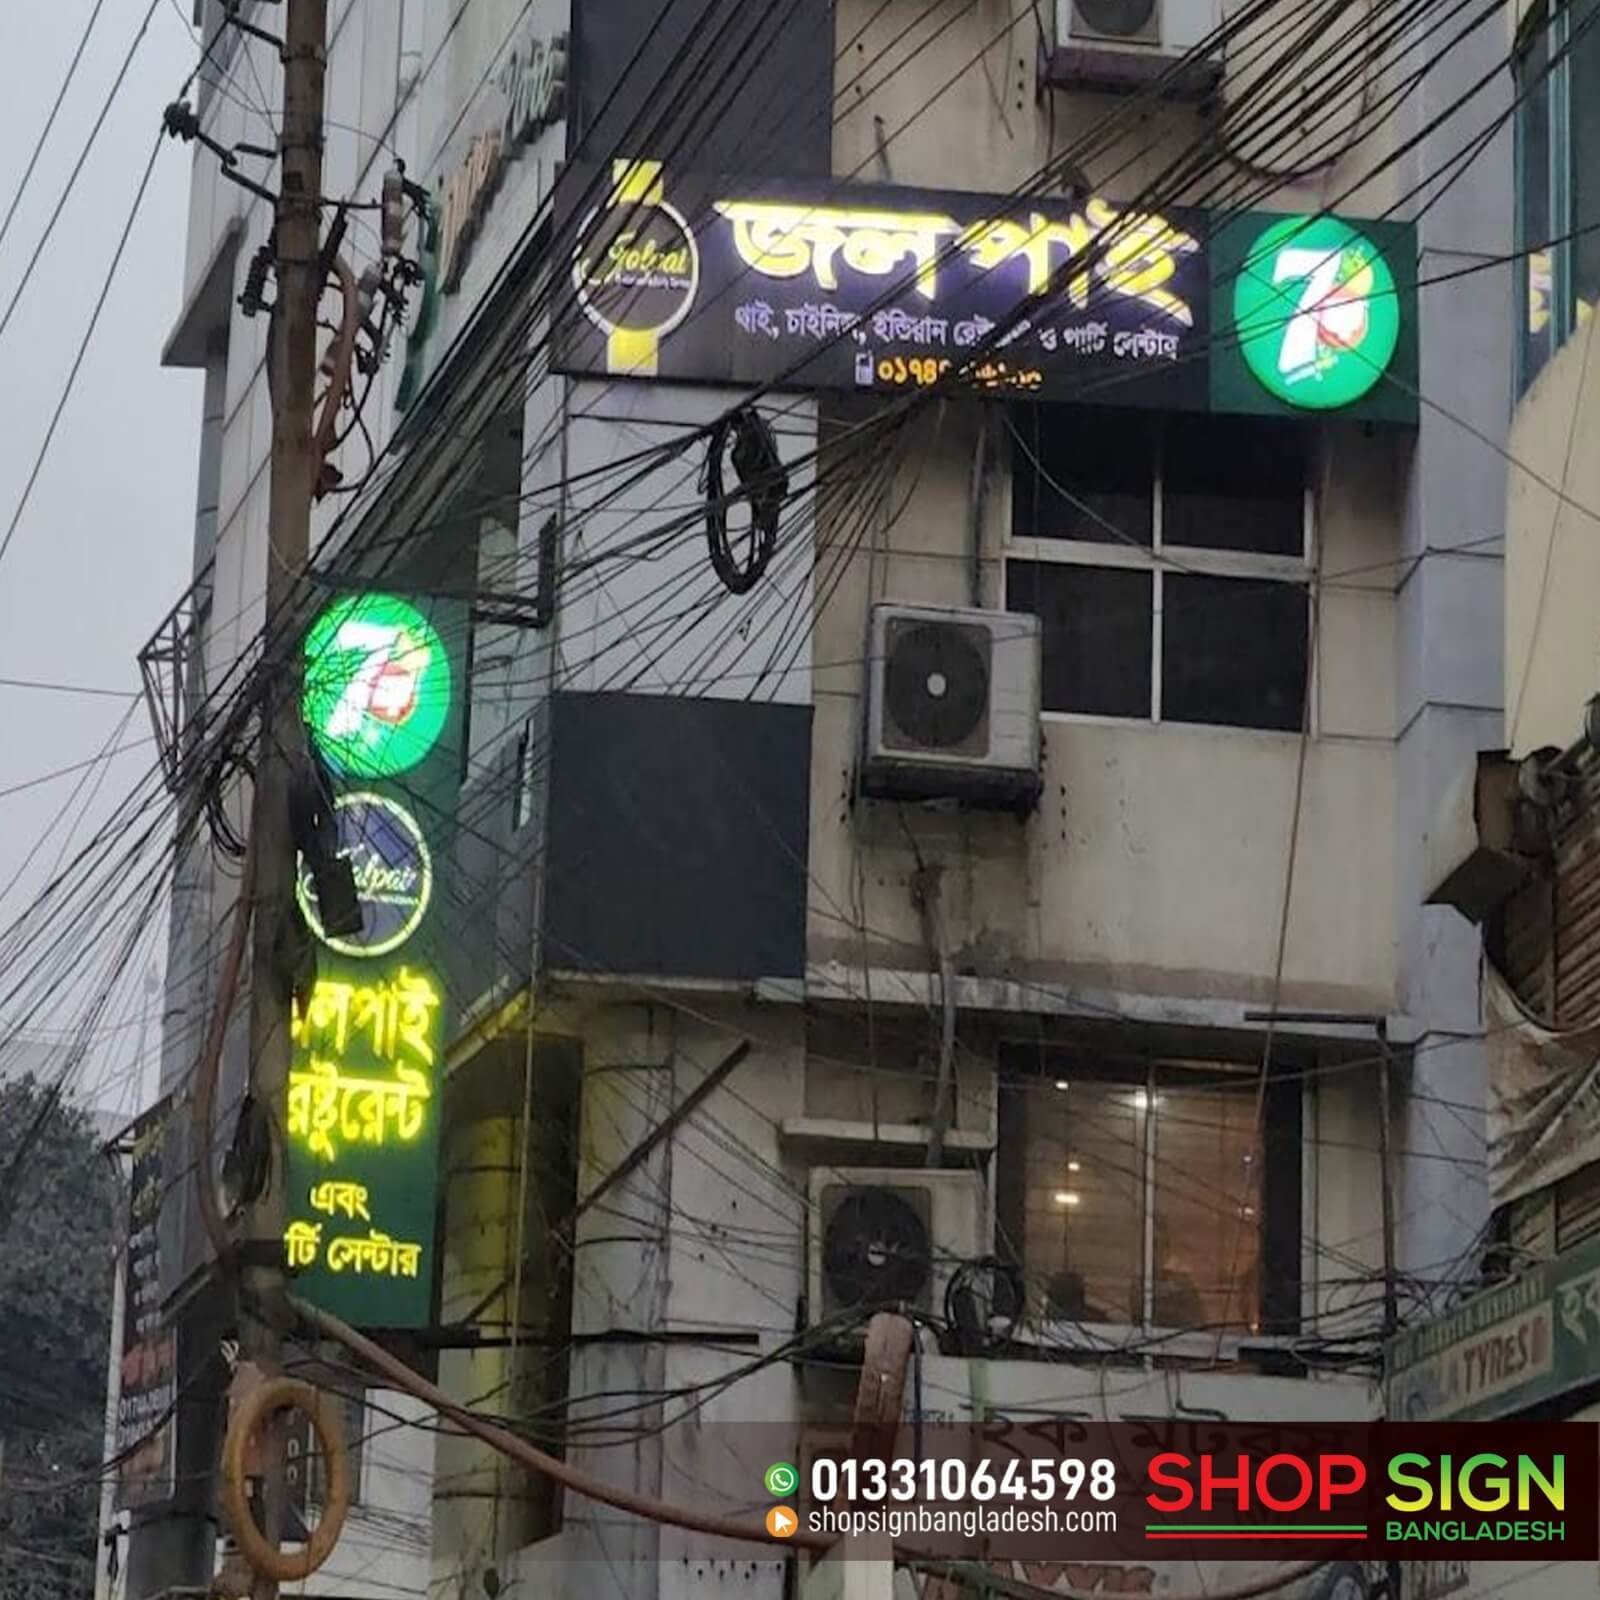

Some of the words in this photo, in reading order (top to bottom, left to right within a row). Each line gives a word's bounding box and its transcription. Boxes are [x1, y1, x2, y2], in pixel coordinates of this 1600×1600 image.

[291, 966, 439, 1067] লপাই
[310, 1181, 371, 1221] এবং
[327, 1228, 422, 1278] সেন্টার
